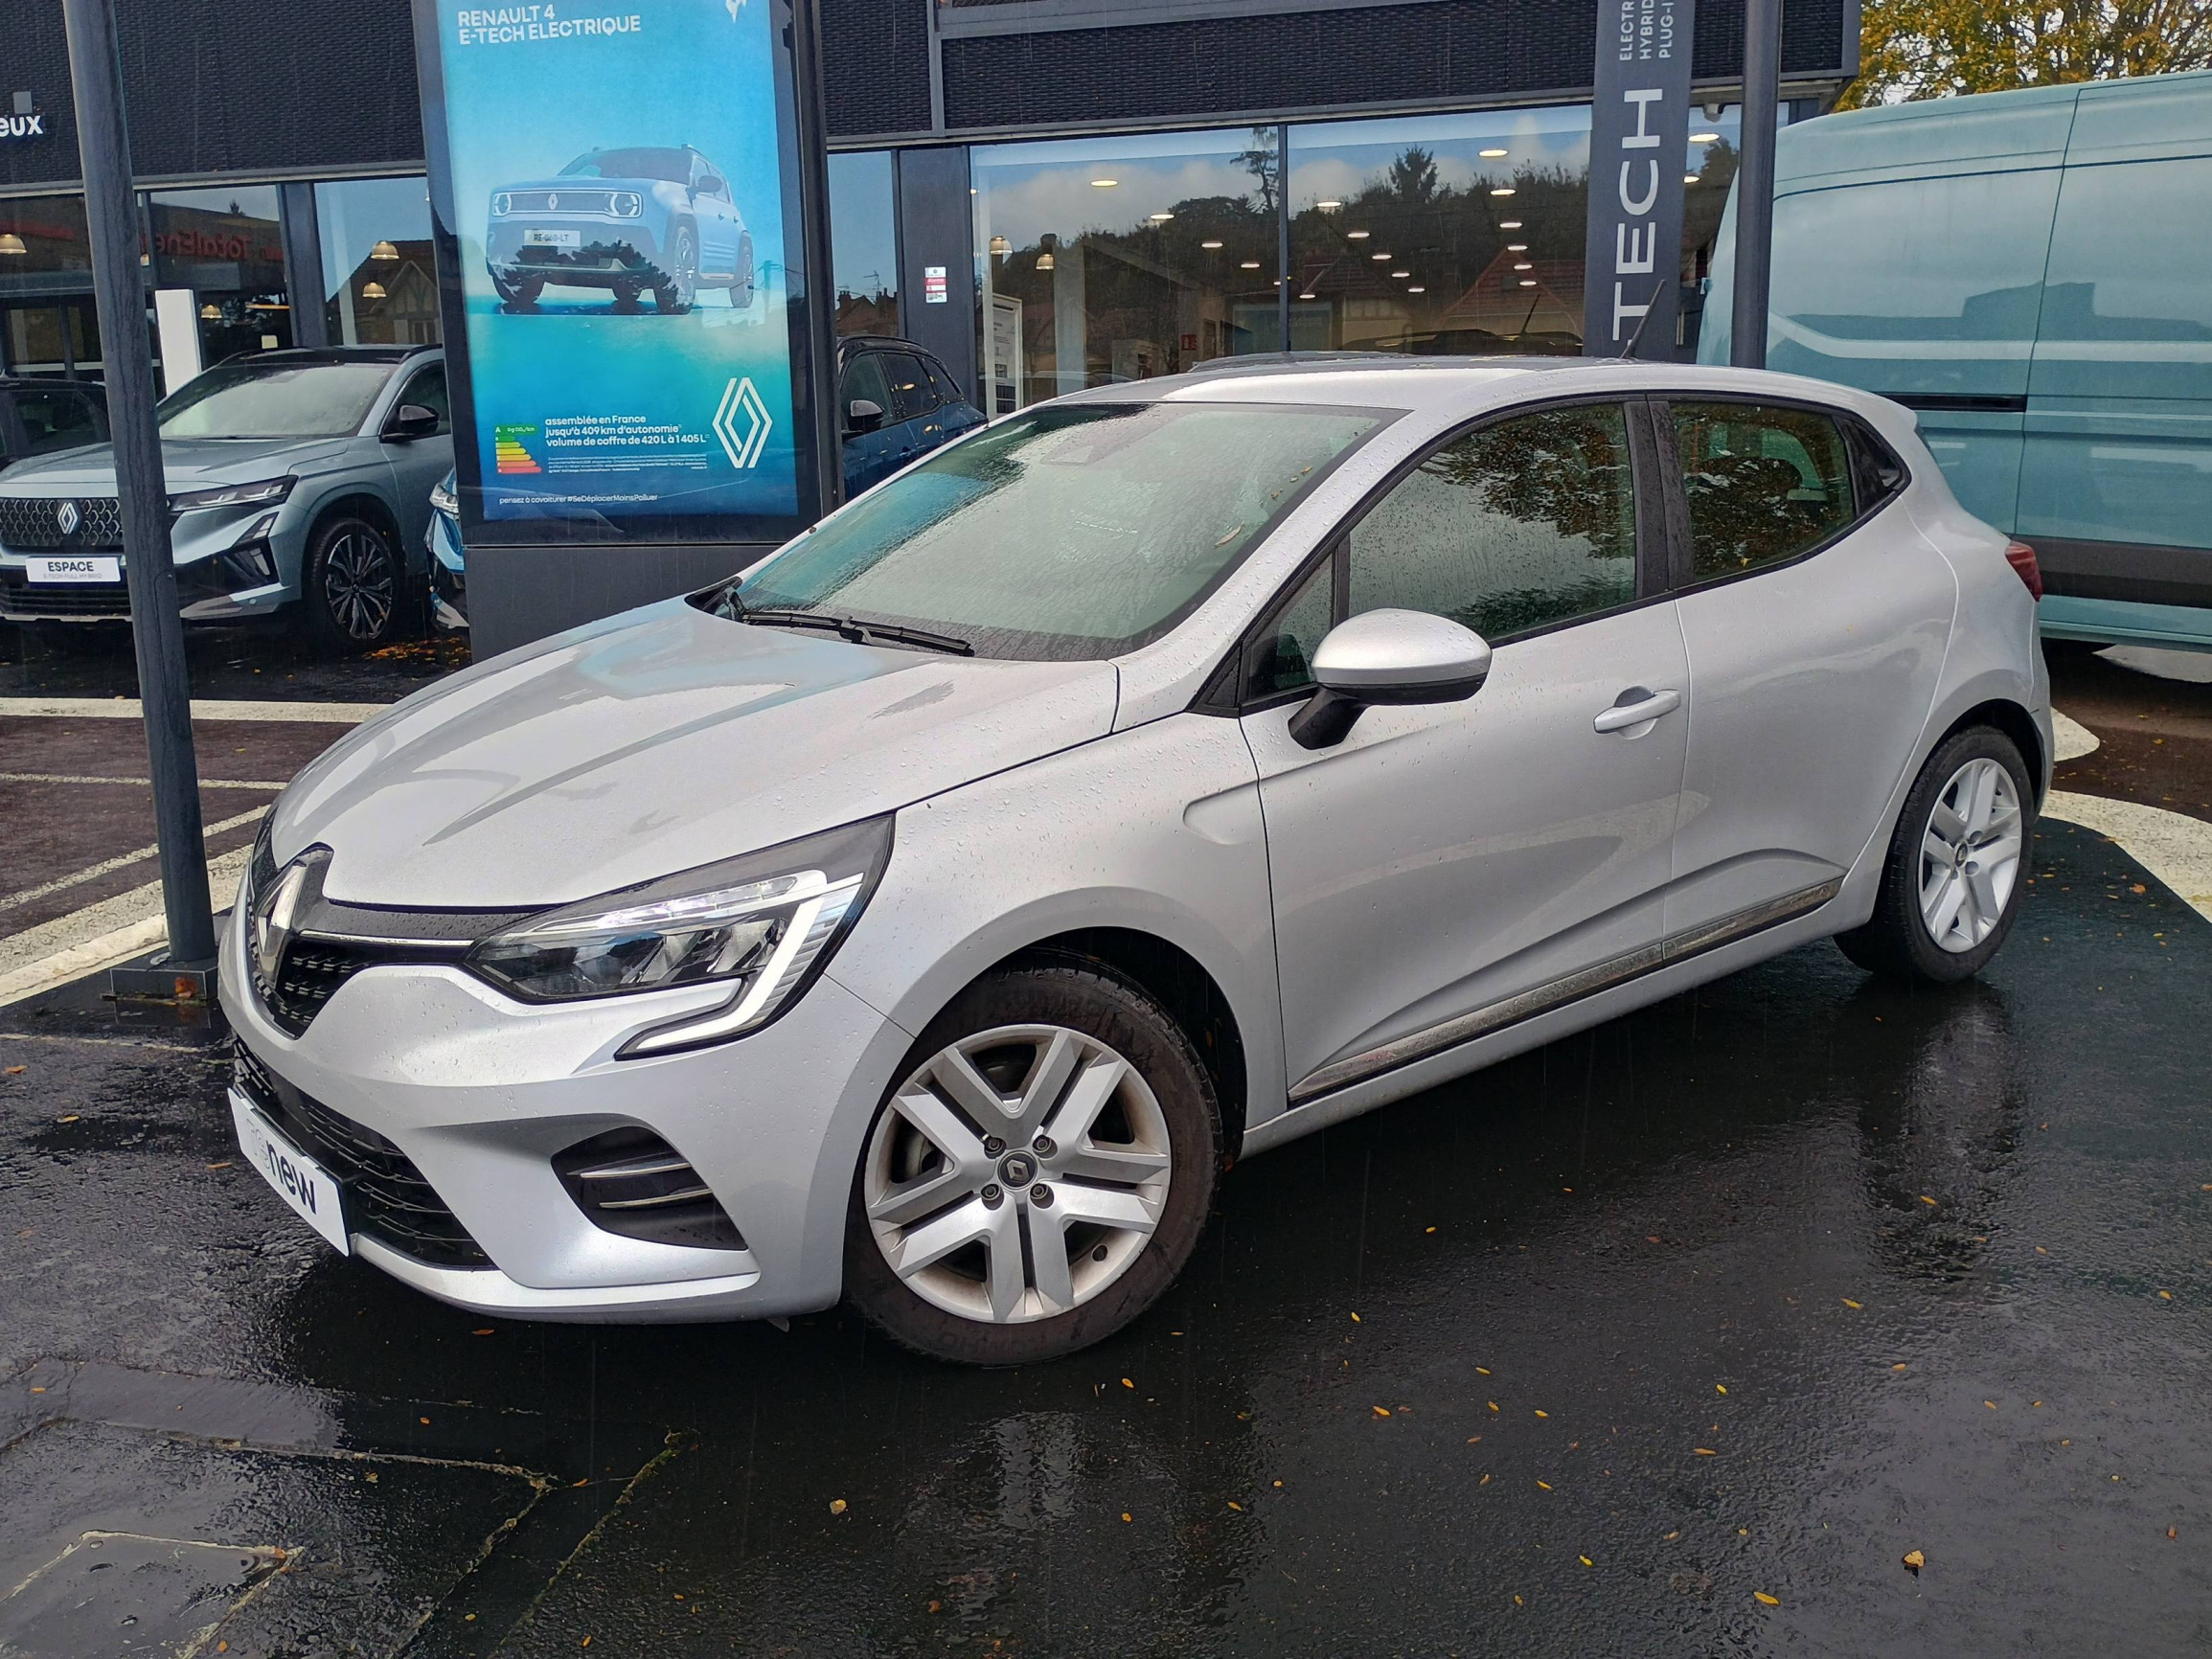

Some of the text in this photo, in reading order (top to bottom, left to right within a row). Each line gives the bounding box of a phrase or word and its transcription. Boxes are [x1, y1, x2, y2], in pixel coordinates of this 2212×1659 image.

[457, 4, 556, 27] RENAULT 4
[459, 15, 641, 45] E-TECH ELECTRIQUE
[1658, 0, 1675, 58] PLUG-I
[1612, 89, 1662, 347] TECH
[545, 415, 597, 426] assemblée
[611, 415, 647, 423] France
[544, 424, 679, 439] jusqu'à 409 km d'autonomie
[545, 438, 582, 447] volume
[582, 437, 596, 446] de
[596, 436, 627, 446] coffre
[627, 436, 641, 444] de
[641, 435, 661, 444] 420
[661, 435, 668, 444] L
[668, 433, 675, 443] à
[499, 497, 525, 506] pensez
[47, 560, 95, 572] ESPACE
